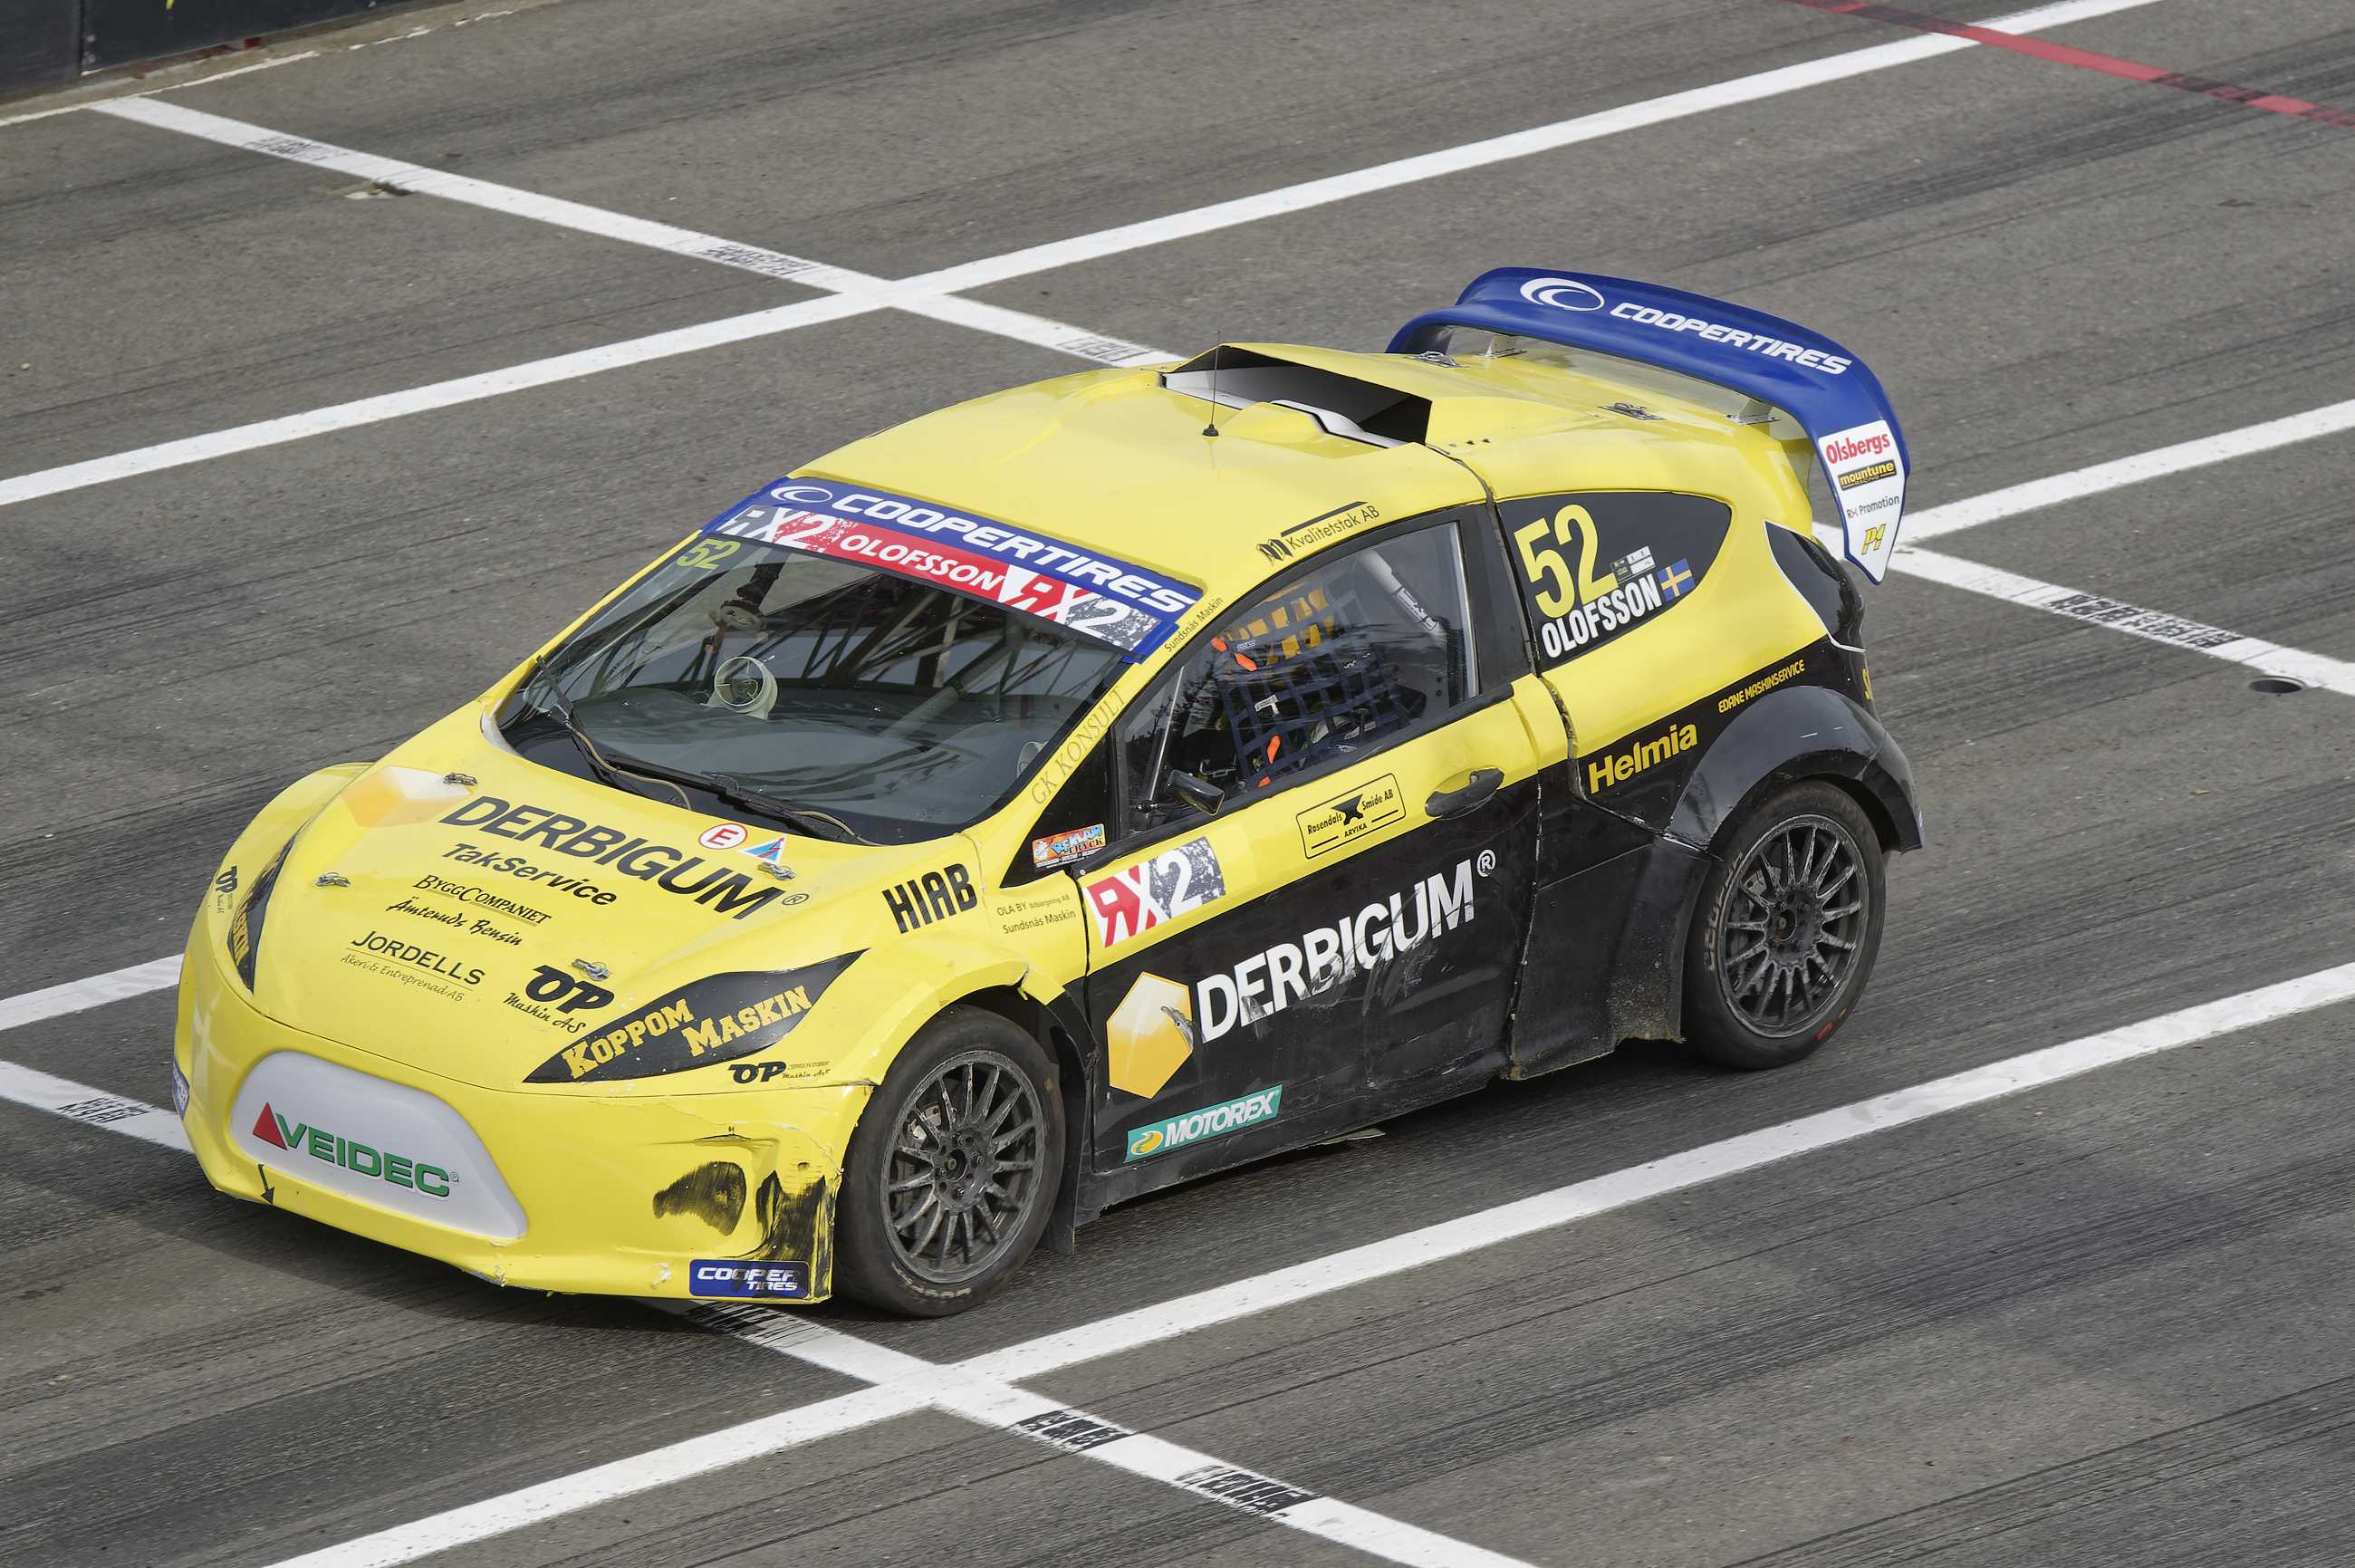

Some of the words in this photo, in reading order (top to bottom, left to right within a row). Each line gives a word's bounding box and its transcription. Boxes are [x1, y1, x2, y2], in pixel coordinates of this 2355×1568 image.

[1825, 433, 1890, 464] Olsbergs
[1840, 463, 1894, 486] mountune
[1859, 495, 1900, 514] Promotion
[1285, 514, 1361, 550] Kvalitetstak
[1361, 505, 1380, 522] AB
[677, 538, 741, 571] 52
[840, 534, 1006, 592] OLOFSSON
[1514, 504, 1620, 618] 52
[1197, 596, 1223, 625] Maskin
[1541, 573, 1662, 659] OLOFSSON
[1061, 686, 1126, 776] KONSULT
[1588, 724, 1698, 794] Helmia
[1307, 813, 1342, 834] Rosendals
[1362, 793, 1383, 811] Smide
[1384, 789, 1394, 801] AB
[1344, 822, 1368, 838] ARVIKA
[441, 842, 618, 906] TakService
[881, 862, 978, 935] HIAB
[996, 905, 1015, 916] OLA
[1015, 901, 1027, 912] BY
[1044, 909, 1076, 924] Maskin
[470, 919, 523, 947] Bensin
[351, 930, 486, 986] JORDELLS
[380, 965, 449, 996] Entreprenad
[447, 987, 465, 1002] AB
[525, 965, 615, 1014] OP
[503, 992, 551, 1022] Maskin
[681, 985, 813, 1057] MASKIN
[561, 998, 696, 1080] KOPPOM
[1164, 1092, 1276, 1148] MOTOREX
